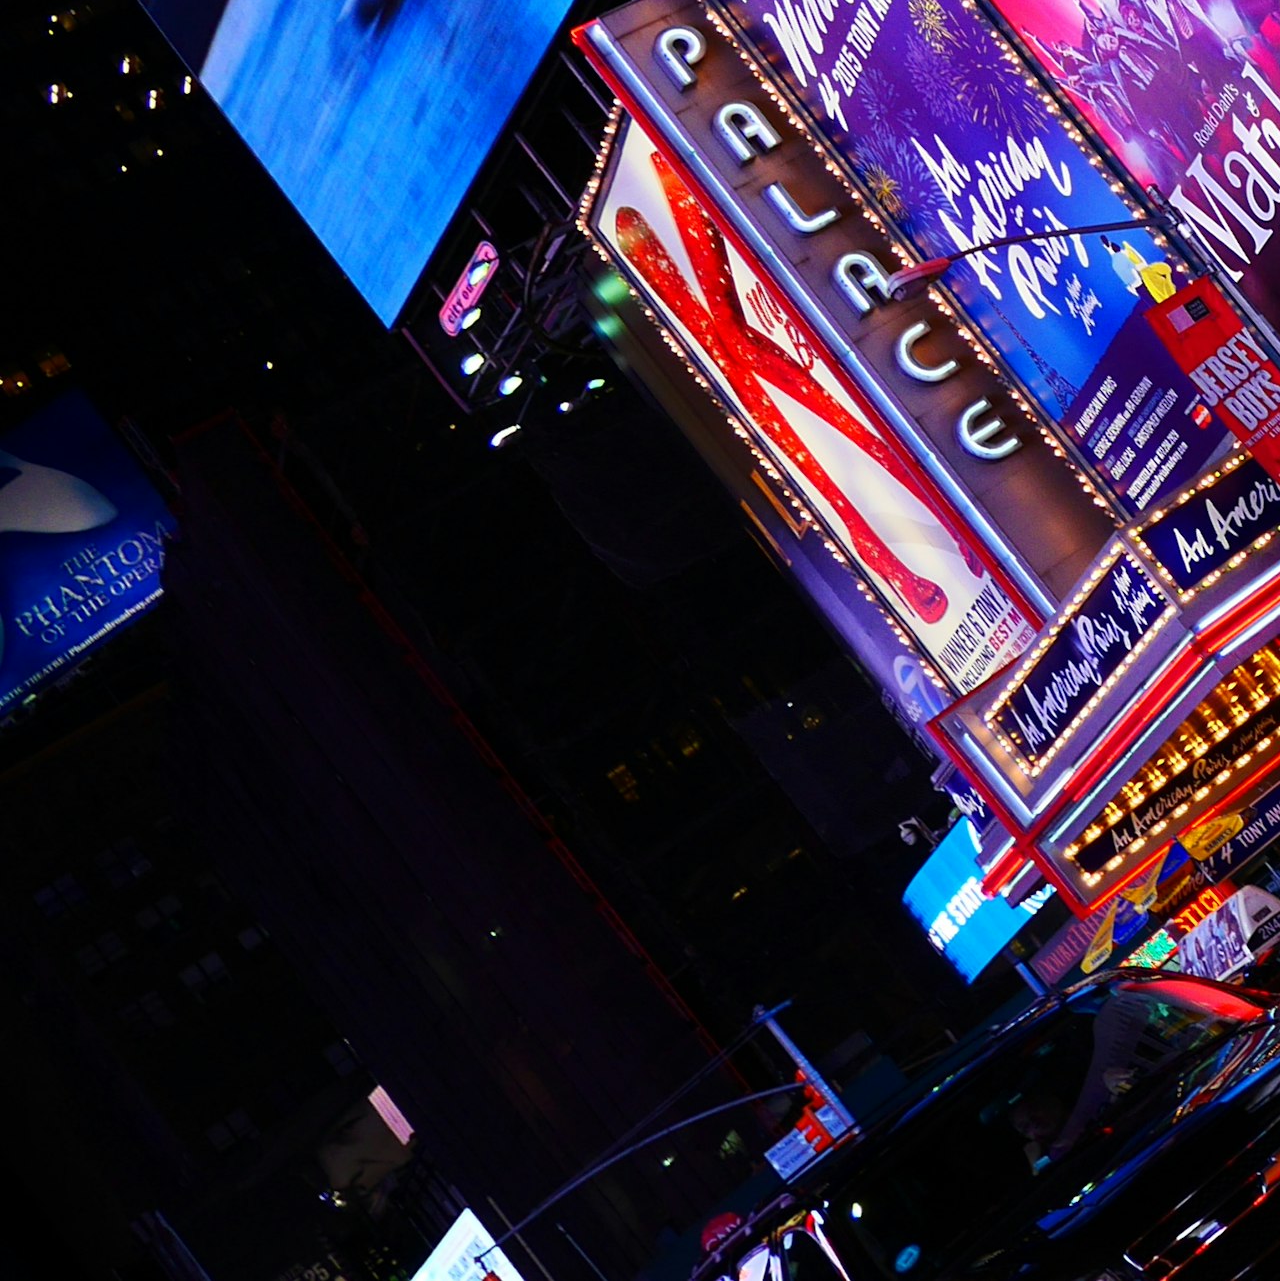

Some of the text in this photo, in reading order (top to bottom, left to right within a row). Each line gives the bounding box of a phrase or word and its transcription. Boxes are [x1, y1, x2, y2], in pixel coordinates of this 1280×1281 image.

[845, 1, 881, 60] TONY
[831, 44, 863, 97] 2015
[1195, 83, 1239, 148] Roald Dahl's
[910, 140, 972, 215] An
[655, 26, 1020, 460] PALACE
[1007, 205, 1090, 320] Paris
[1100, 375, 1117, 399] PARIS
[1188, 326, 1269, 407] JERSEY
[1074, 421, 1085, 437] AN
[1079, 395, 1104, 430] AMERICAN
[1093, 436, 1111, 460] GEORGE
[60, 542, 101, 575] THE
[1173, 527, 1214, 573] An
[15, 518, 173, 638] PHANTOM
[41, 619, 67, 646] OF
[71, 588, 111, 624] THE
[937, 583, 1004, 676] WINNER! 6 TONY
[959, 644, 996, 693] INCLUDING
[988, 617, 1014, 652] BEST
[906, 699, 924, 723] abc
[1012, 612, 1132, 756] An American Paris
[1112, 826, 1134, 853] An
[1235, 817, 1268, 848] TONY
[932, 911, 959, 943] THE
